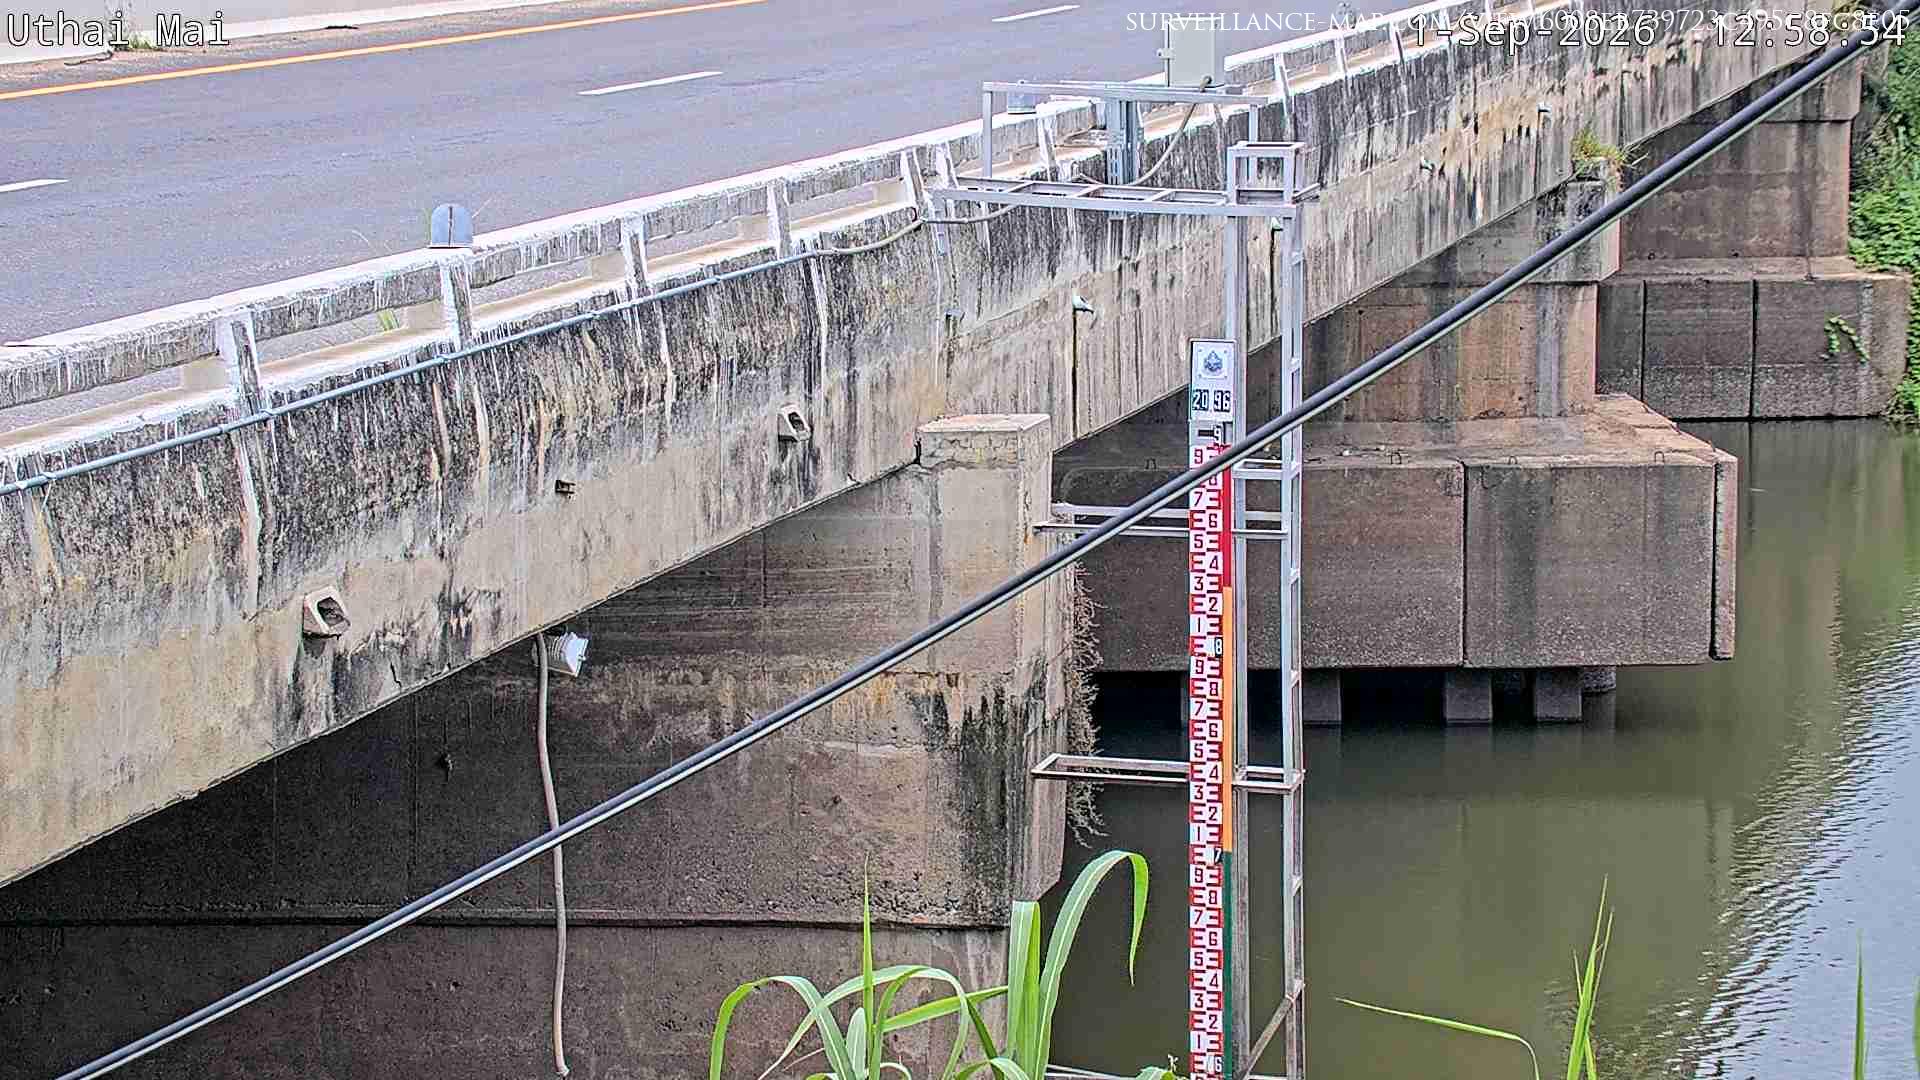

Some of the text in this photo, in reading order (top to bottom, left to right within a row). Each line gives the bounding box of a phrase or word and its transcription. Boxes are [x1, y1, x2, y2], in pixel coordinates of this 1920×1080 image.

[1194, 448, 1203, 465] 9
[1194, 491, 1203, 507] 7
[1208, 513, 1218, 528] 6
[1194, 534, 1204, 549] 5
[1209, 555, 1219, 570] 4
[1194, 576, 1204, 591] 3
[1208, 597, 1218, 612] 2
[1195, 659, 1204, 675] 9
[1209, 681, 1219, 696] 8
[1195, 701, 1204, 716] 7
[1208, 723, 1218, 738] 6
[1194, 743, 1204, 758] 5
[1209, 764, 1219, 780] 4
[1194, 785, 1204, 800] 3
[1208, 806, 1218, 821] 2
[1194, 867, 1204, 883] 9
[1208, 890, 1218, 905] 8
[1194, 909, 1203, 925] 7
[1208, 931, 1218, 946] 6
[1194, 952, 1204, 967] 5
[1209, 973, 1219, 988] 4
[1194, 993, 1204, 1008] 3
[1208, 1014, 1218, 1029] 2
